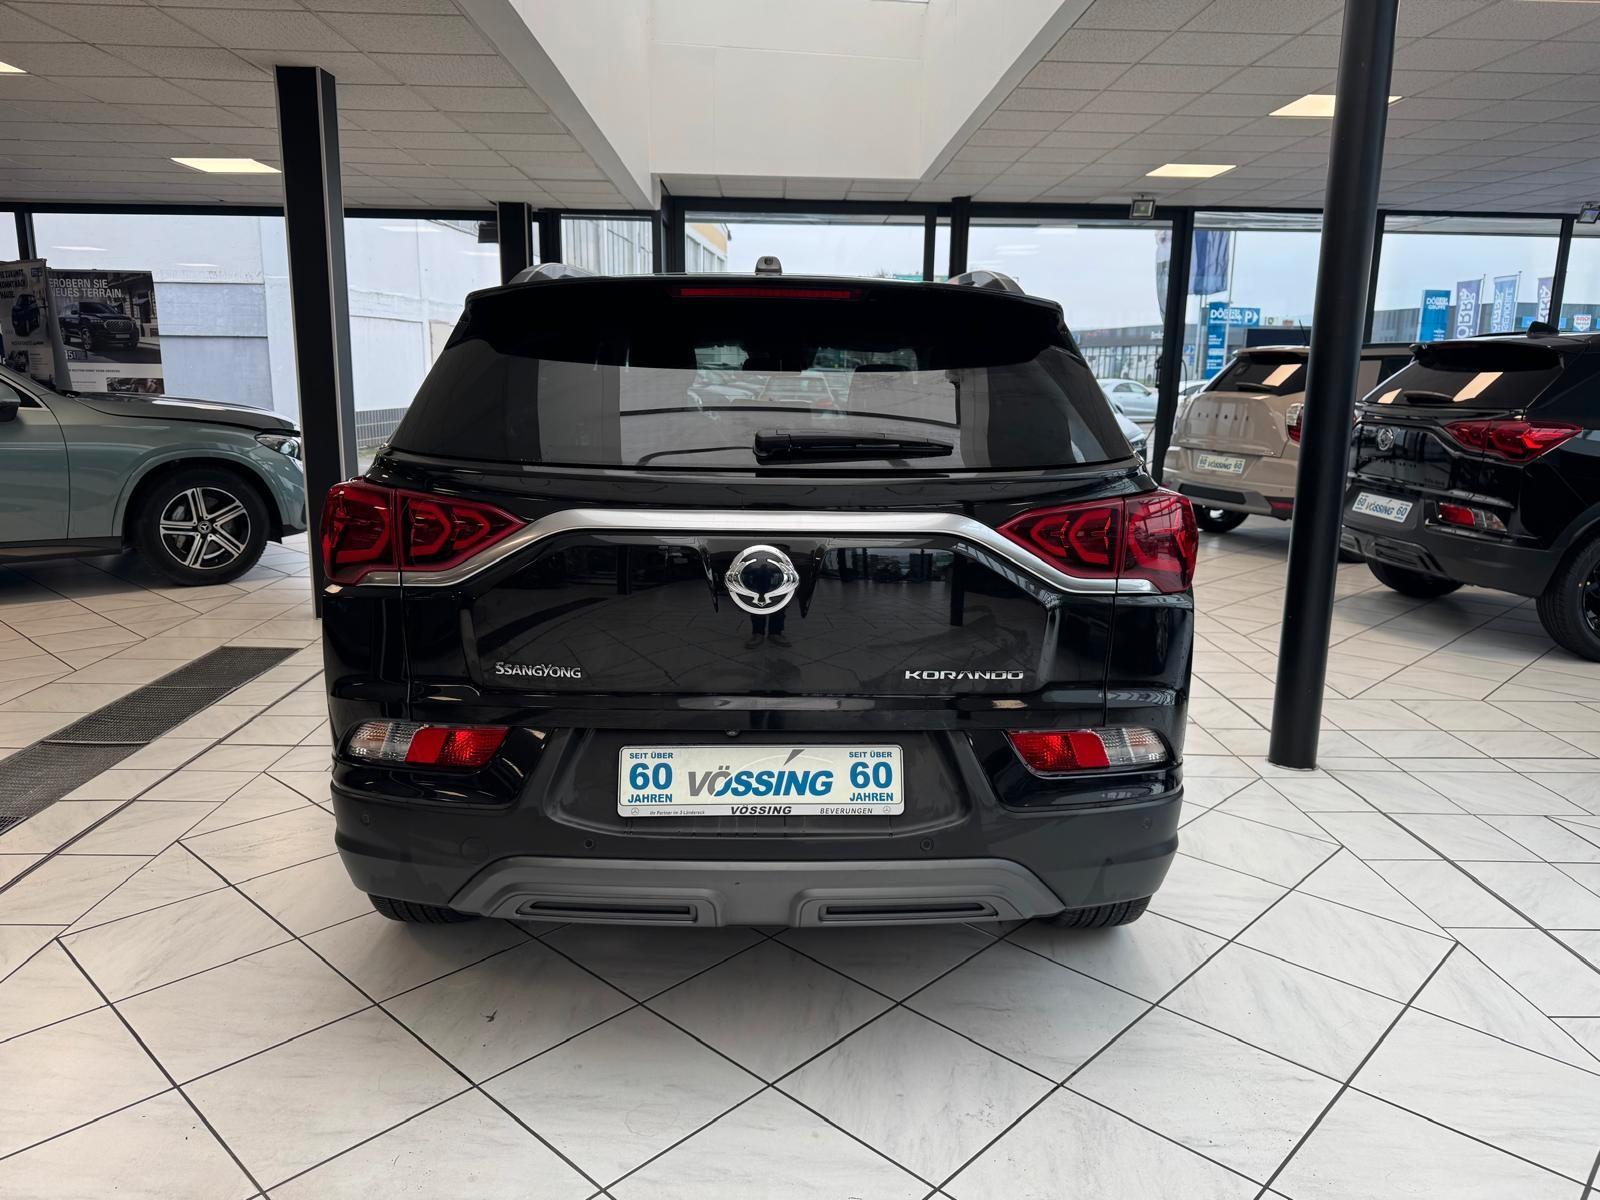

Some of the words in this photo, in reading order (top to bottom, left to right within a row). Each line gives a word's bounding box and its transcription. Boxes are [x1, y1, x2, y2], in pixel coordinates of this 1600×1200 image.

[49, 278, 91, 289] EROBERN
[93, 279, 109, 289] SIE
[82, 288, 125, 298] TERRAIN.
[1356, 496, 1367, 507] 60
[1395, 505, 1408, 517] 60
[904, 670, 1024, 680] KORANDO
[629, 752, 649, 760] SEIT
[650, 751, 674, 760] ÜBER
[869, 750, 893, 758] ÜBER
[629, 762, 673, 791] 60
[687, 764, 834, 797] VÖSSING
[849, 761, 893, 789] 60
[628, 793, 673, 804] JAHREN
[849, 792, 894, 802] JAHREN
[731, 804, 792, 815] VÖSSING
